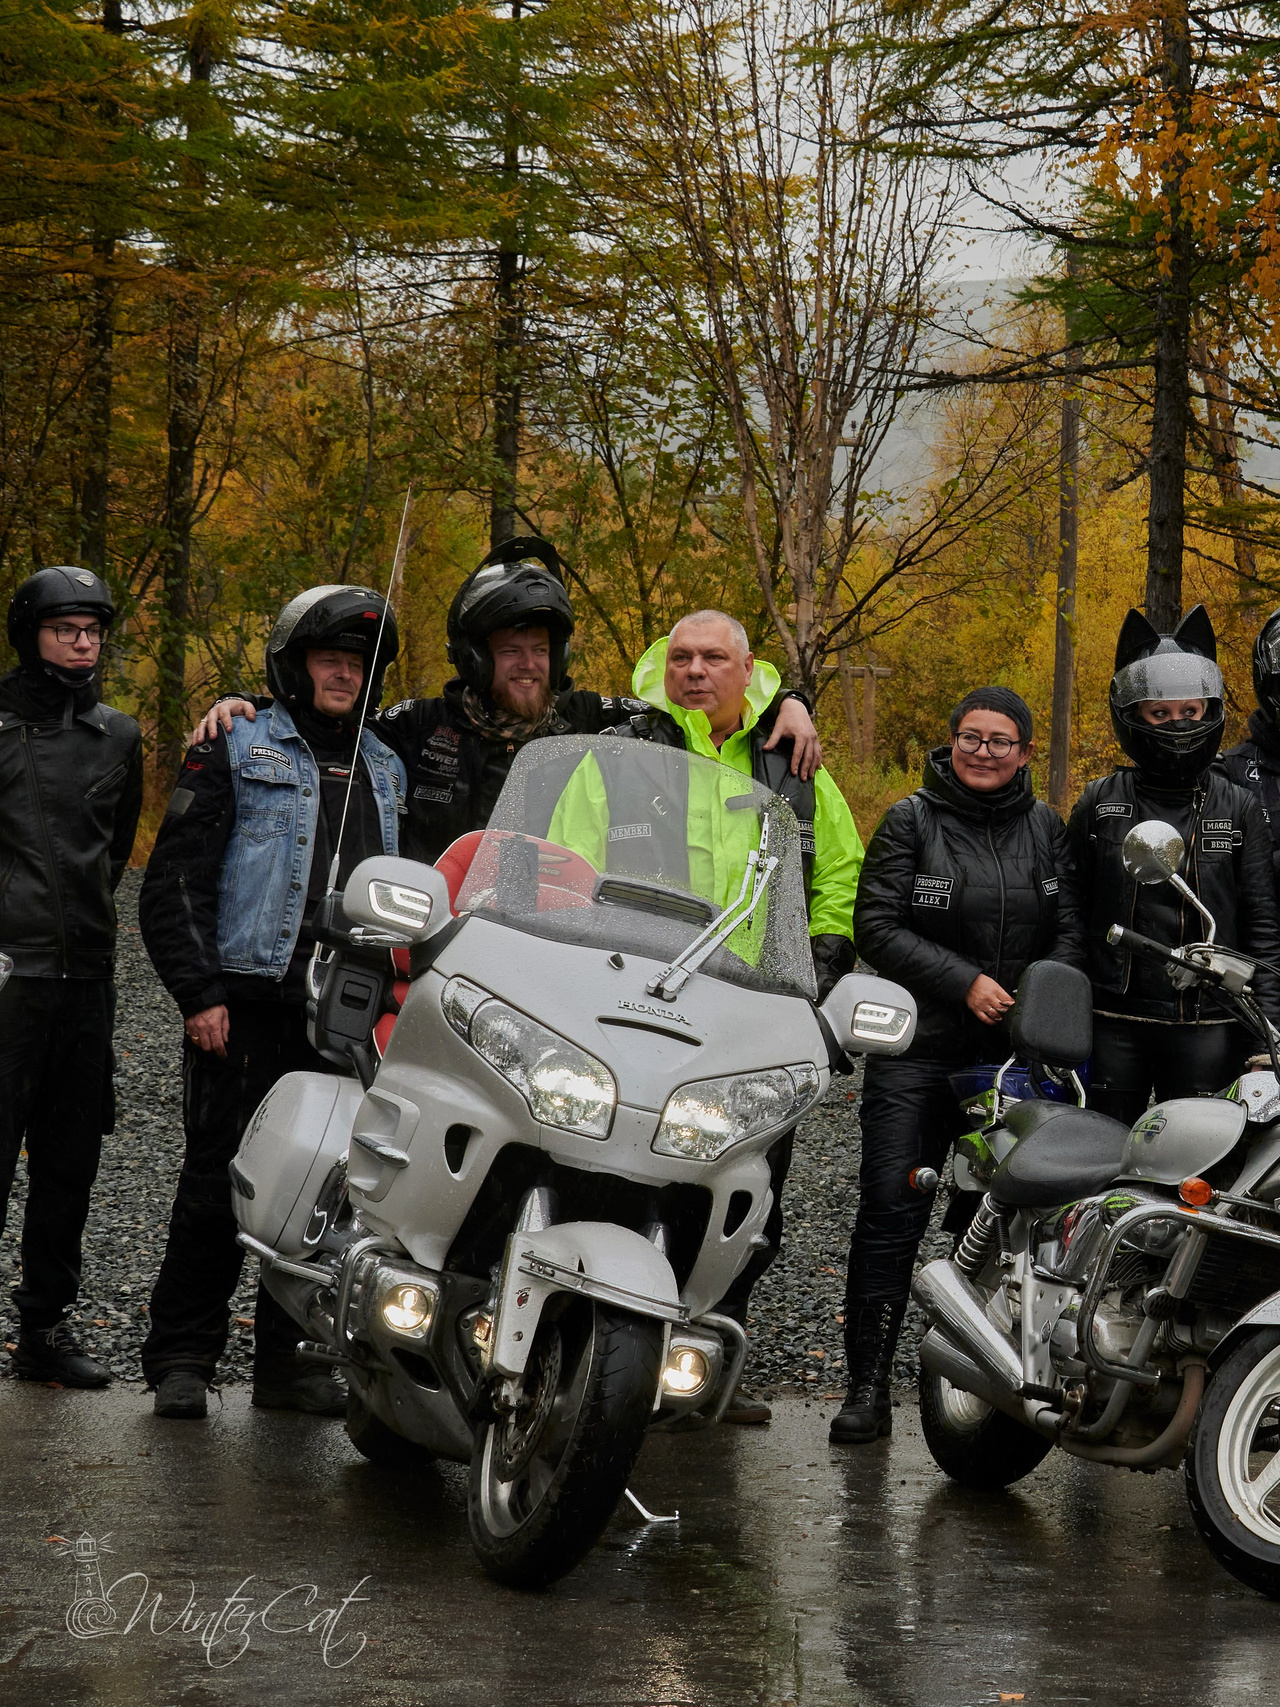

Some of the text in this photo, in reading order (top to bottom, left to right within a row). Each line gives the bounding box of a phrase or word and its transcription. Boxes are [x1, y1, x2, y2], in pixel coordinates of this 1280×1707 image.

[252, 747, 289, 764] PRESIDENT
[416, 787, 450, 801] PROSPECT
[1098, 805, 1125, 815] MEMBER
[609, 825, 649, 840] MEMBER
[916, 876, 950, 890] PROSPECT
[918, 894, 941, 905] ALEX
[617, 1000, 692, 1026] HONDA
